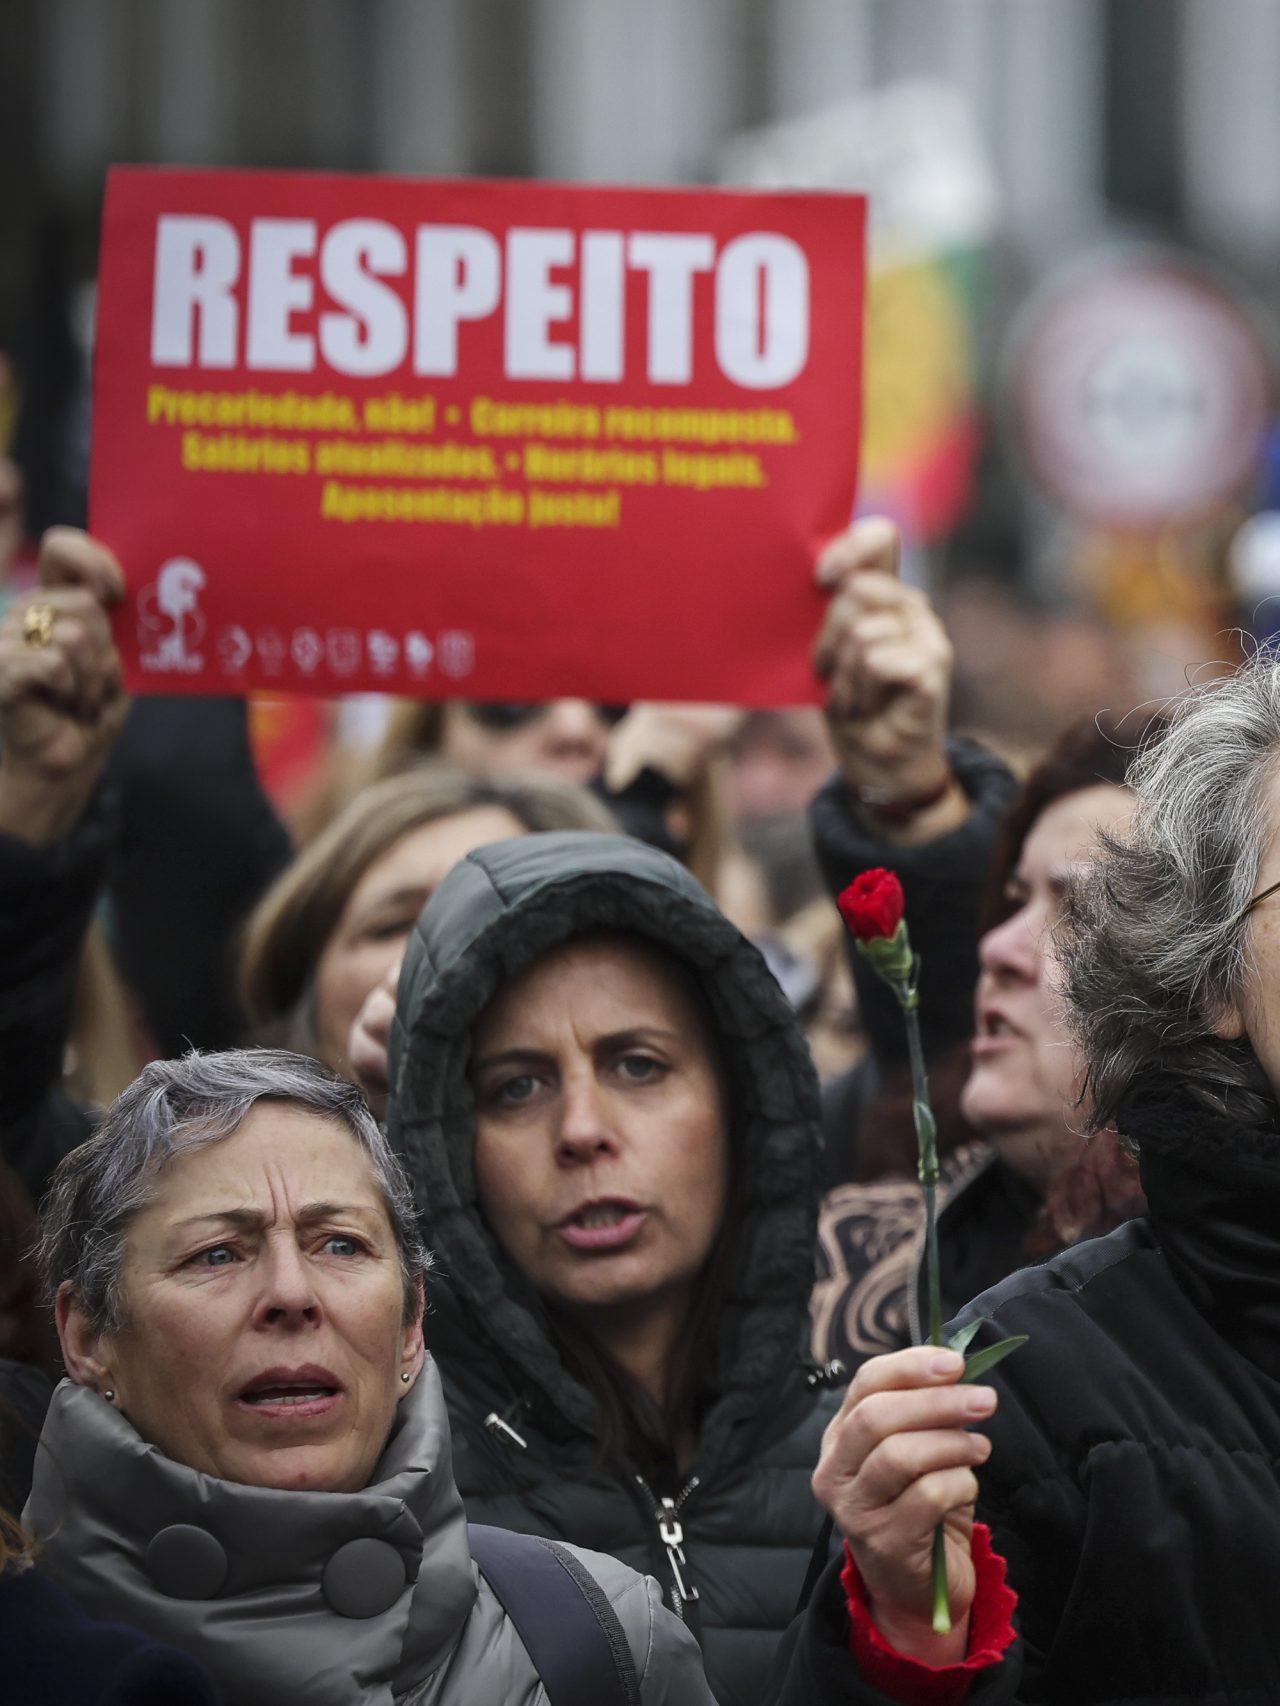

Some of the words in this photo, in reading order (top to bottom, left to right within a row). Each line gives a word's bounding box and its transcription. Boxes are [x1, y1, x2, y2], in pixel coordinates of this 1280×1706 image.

[151, 212, 810, 390] RESPEITO
[364, 395, 436, 434] não!
[470, 397, 600, 440] Carreira
[183, 431, 311, 474] Salários
[528, 489, 621, 528] justa!
